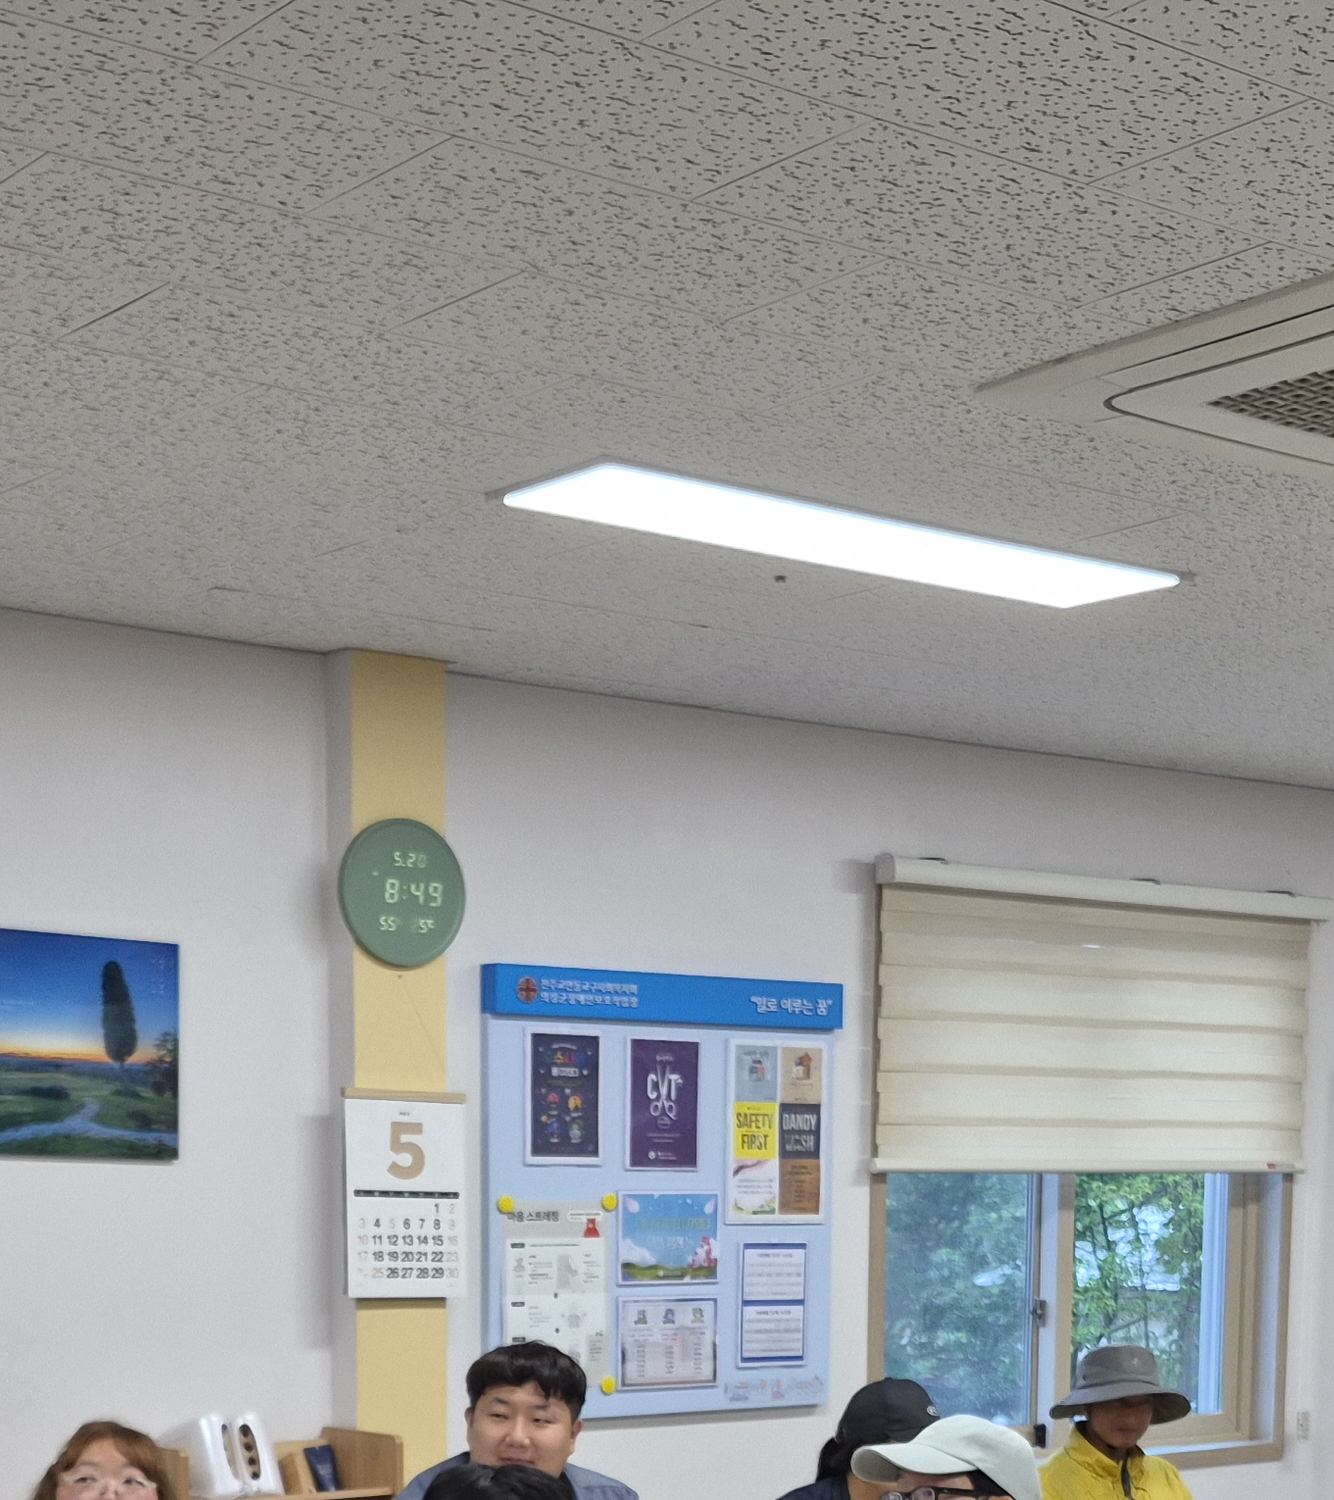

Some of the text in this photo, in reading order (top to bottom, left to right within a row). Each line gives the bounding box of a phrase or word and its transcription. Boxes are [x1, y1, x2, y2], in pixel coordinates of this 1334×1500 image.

[384, 878, 443, 907] 8:49
[780, 998, 814, 1016] 이루는
[736, 1113, 774, 1130] SAFETY
[741, 1134, 770, 1151] FIRST
[386, 1121, 426, 1181] 5
[434, 1203, 440, 1214] 1
[526, 1210, 559, 1222] 스트레칭
[374, 1218, 381, 1229] 4
[403, 1218, 411, 1230] 6
[418, 1219, 426, 1230] 7
[433, 1219, 441, 1230] 8
[372, 1235, 383, 1246] 11
[387, 1235, 399, 1246] 12
[402, 1235, 414, 1247] 13
[417, 1235, 429, 1246] 14
[432, 1235, 444, 1247] 15
[372, 1251, 384, 1262] 18
[387, 1251, 399, 1262] 19
[401, 1251, 414, 1263] 20
[416, 1251, 428, 1263] 21
[431, 1251, 444, 1263] 22
[386, 1267, 400, 1279] 26
[401, 1268, 414, 1279] 27
[416, 1268, 430, 1279] 28
[431, 1268, 444, 1279] 29
